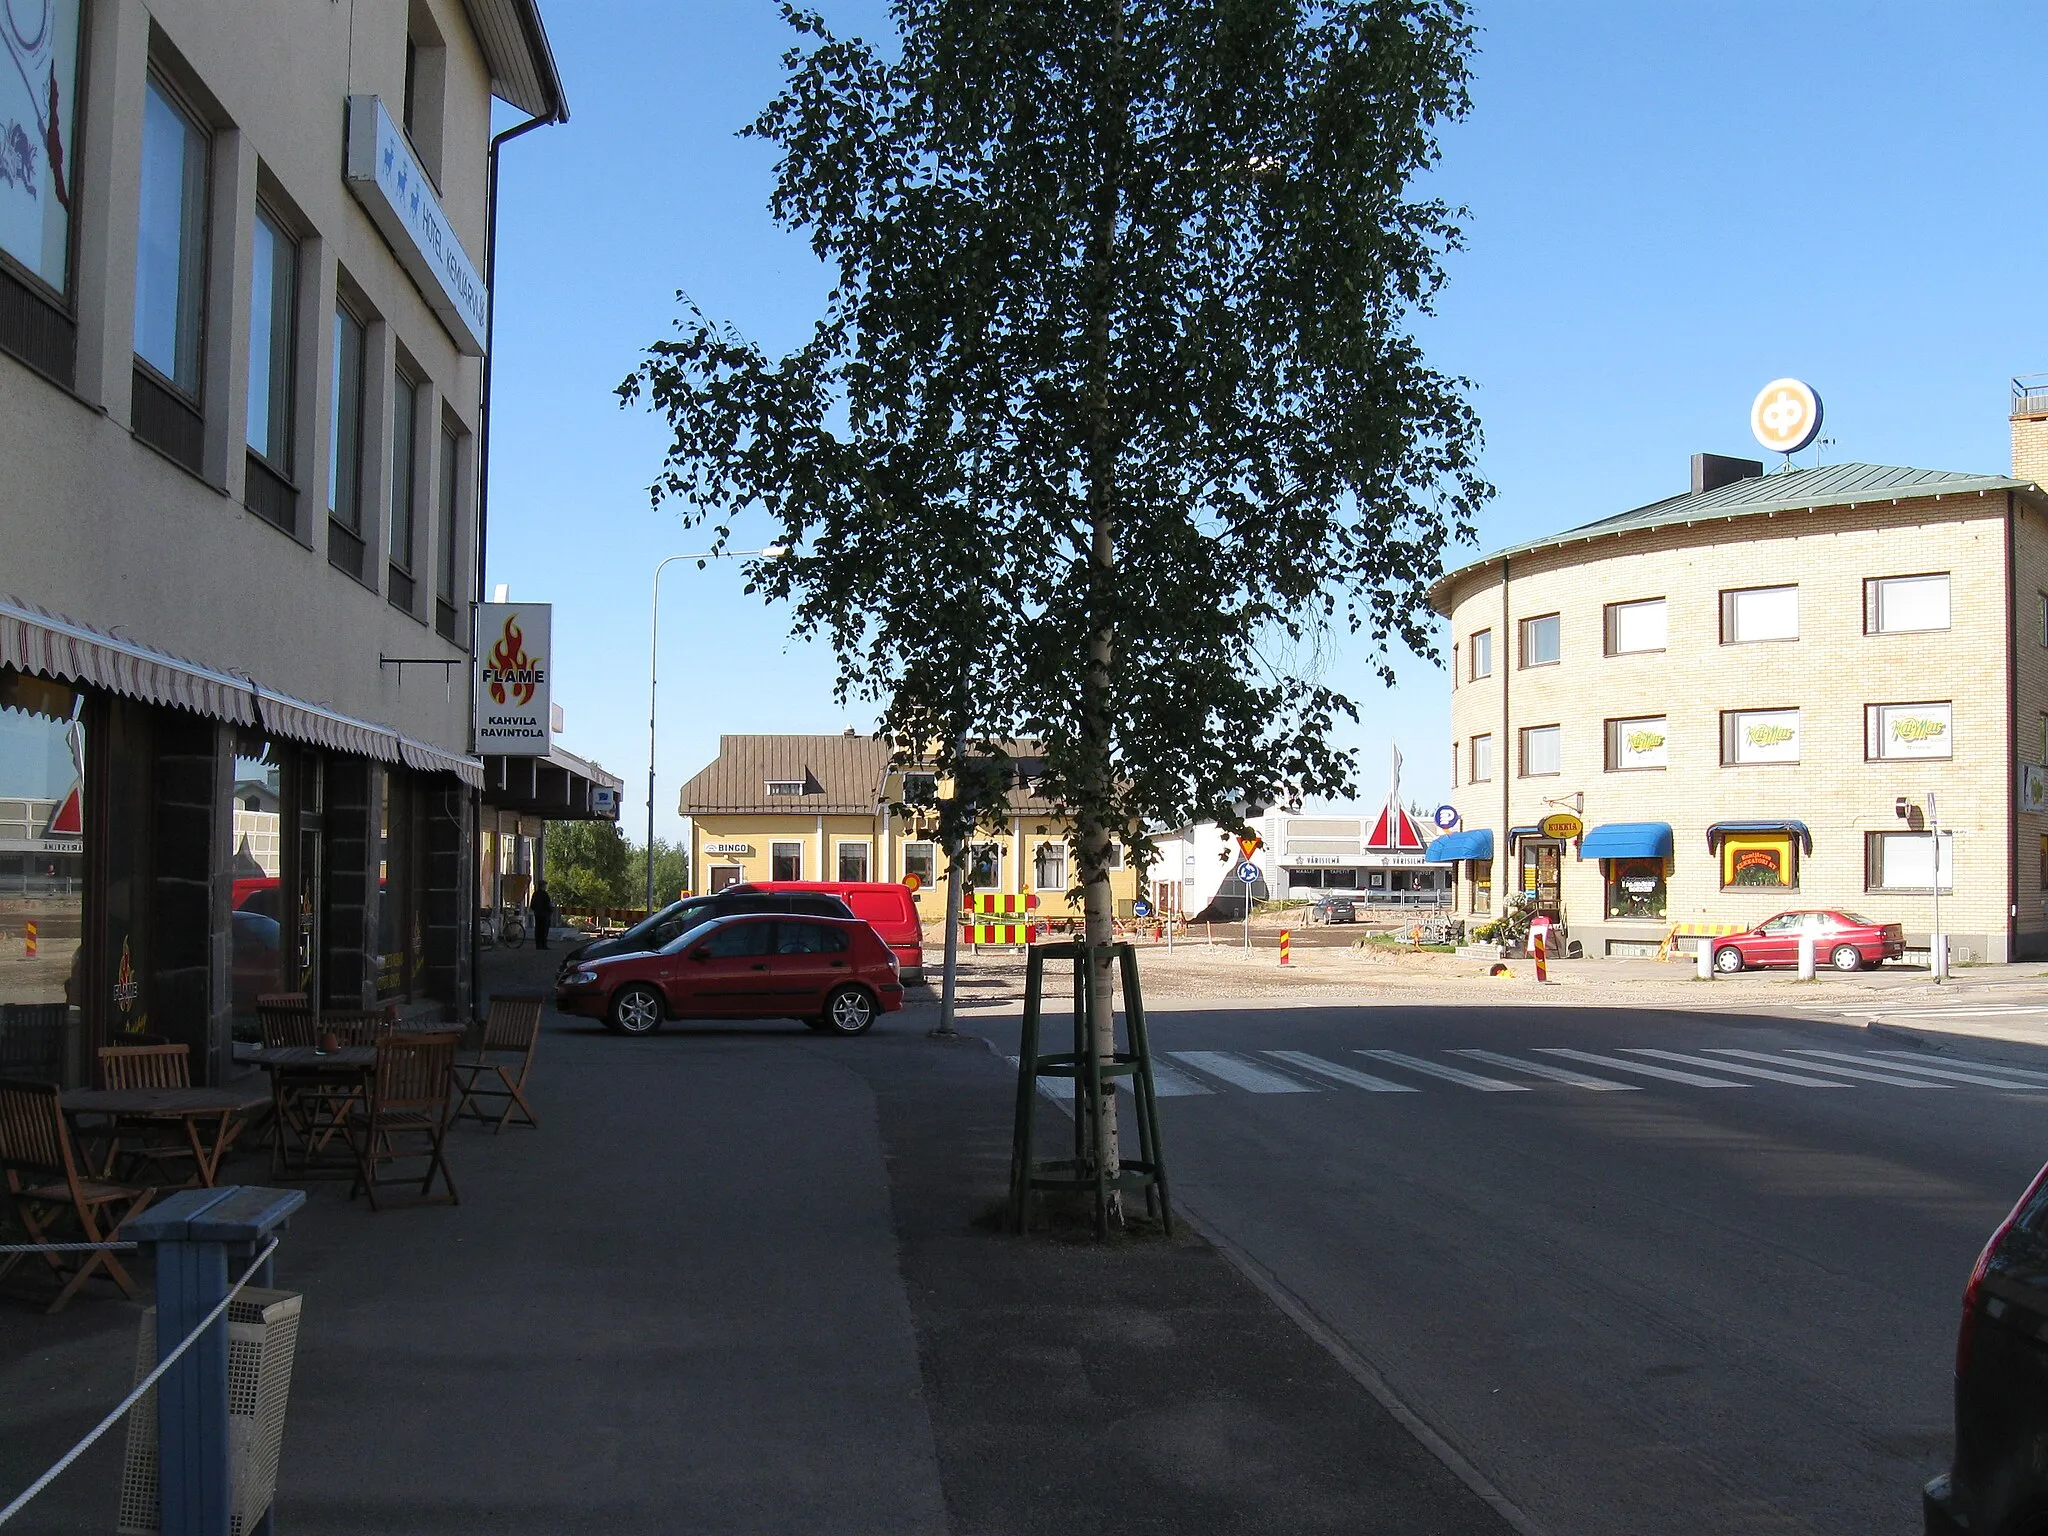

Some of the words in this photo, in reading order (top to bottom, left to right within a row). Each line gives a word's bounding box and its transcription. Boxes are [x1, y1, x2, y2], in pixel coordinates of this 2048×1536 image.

[422, 203, 443, 264] HOTEL
[482, 669, 545, 684] FLAME
[488, 716, 537, 726] KAHVILA
[481, 728, 545, 738] RAVINTOLA
[1548, 822, 1578, 832] KUKKIA
[718, 844, 747, 852] BINGO
[1307, 856, 1340, 864] VÄRISILMÄ
